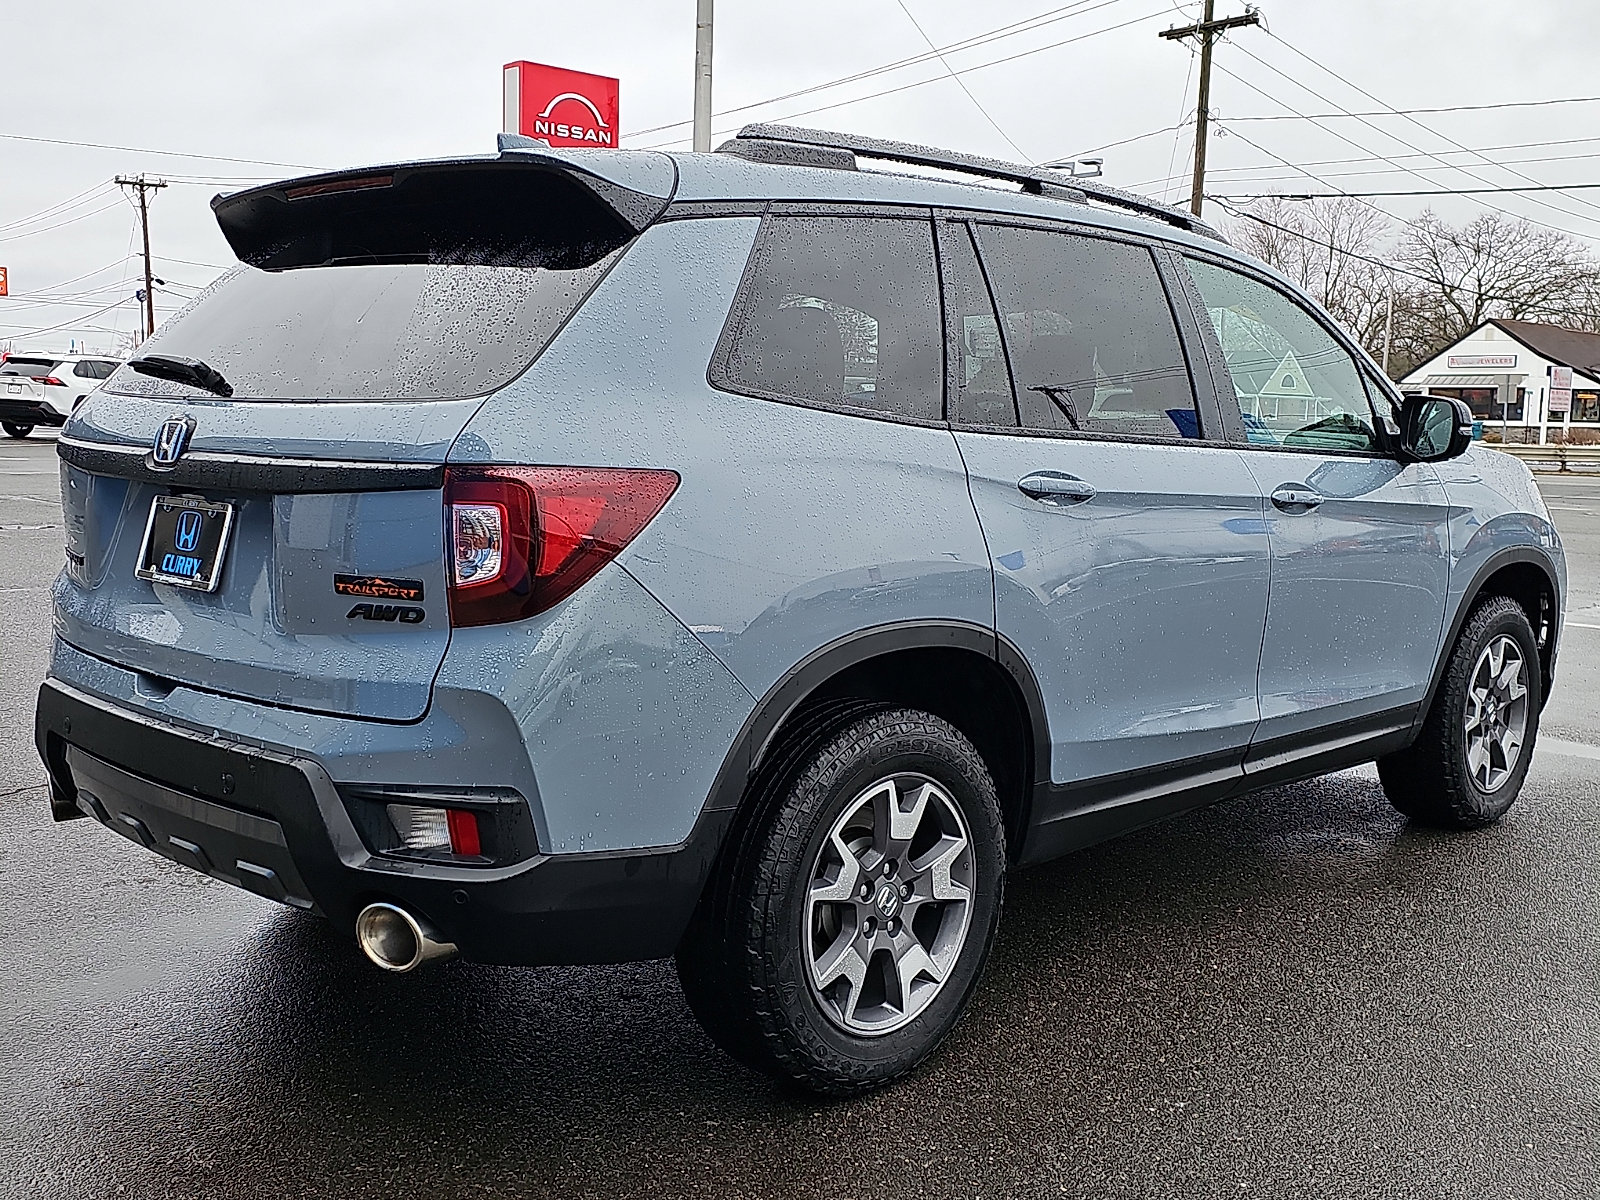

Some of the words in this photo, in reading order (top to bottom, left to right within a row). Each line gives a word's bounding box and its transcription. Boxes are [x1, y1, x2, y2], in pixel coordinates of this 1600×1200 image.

[535, 120, 611, 144] NISSAN
[1477, 357, 1513, 365] JEWELERS
[161, 553, 202, 577] CURRY
[335, 583, 419, 599] TRAILSPORT
[345, 602, 426, 624] AWD
